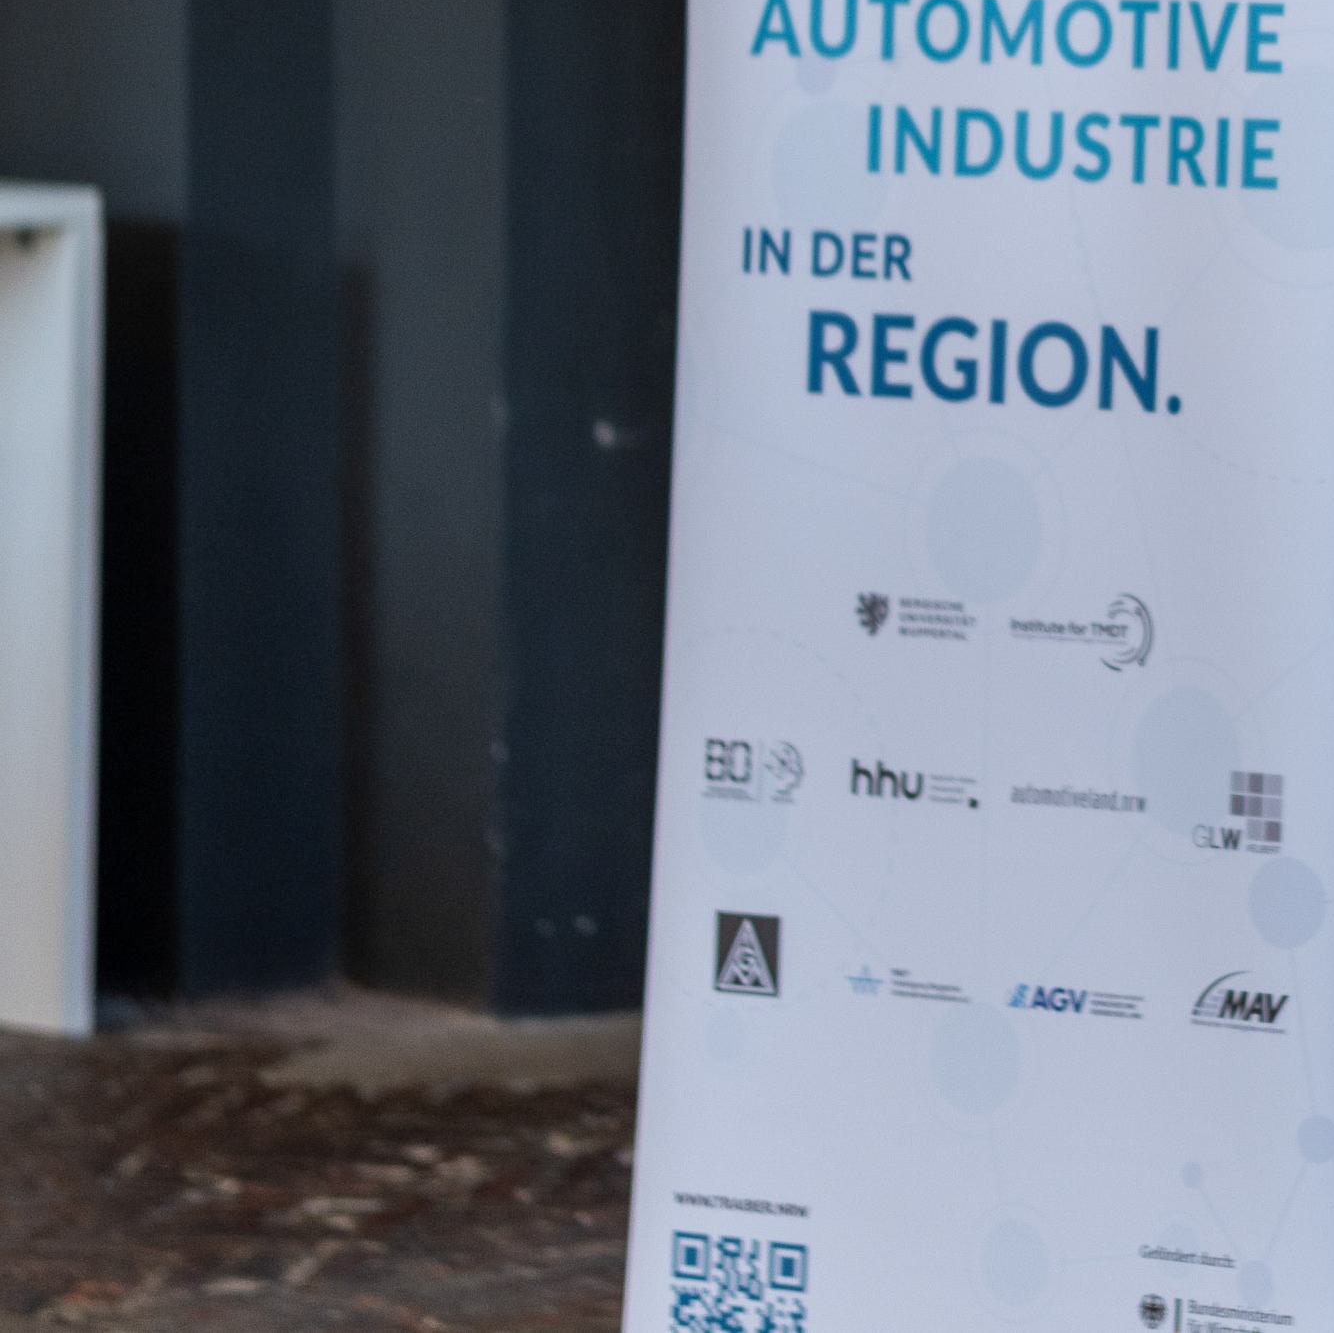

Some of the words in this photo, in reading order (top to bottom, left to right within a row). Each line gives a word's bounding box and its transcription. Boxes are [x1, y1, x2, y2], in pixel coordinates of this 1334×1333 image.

[866, 104, 1281, 190] INDUSTRIE
[742, 226, 792, 275] IN
[810, 230, 913, 281] DER
[806, 309, 1183, 415] REGION.
[850, 757, 923, 800] hhu
[1192, 823, 1242, 851] GLW
[1031, 985, 1088, 1013] AGV
[1217, 989, 1290, 1024] MAV
